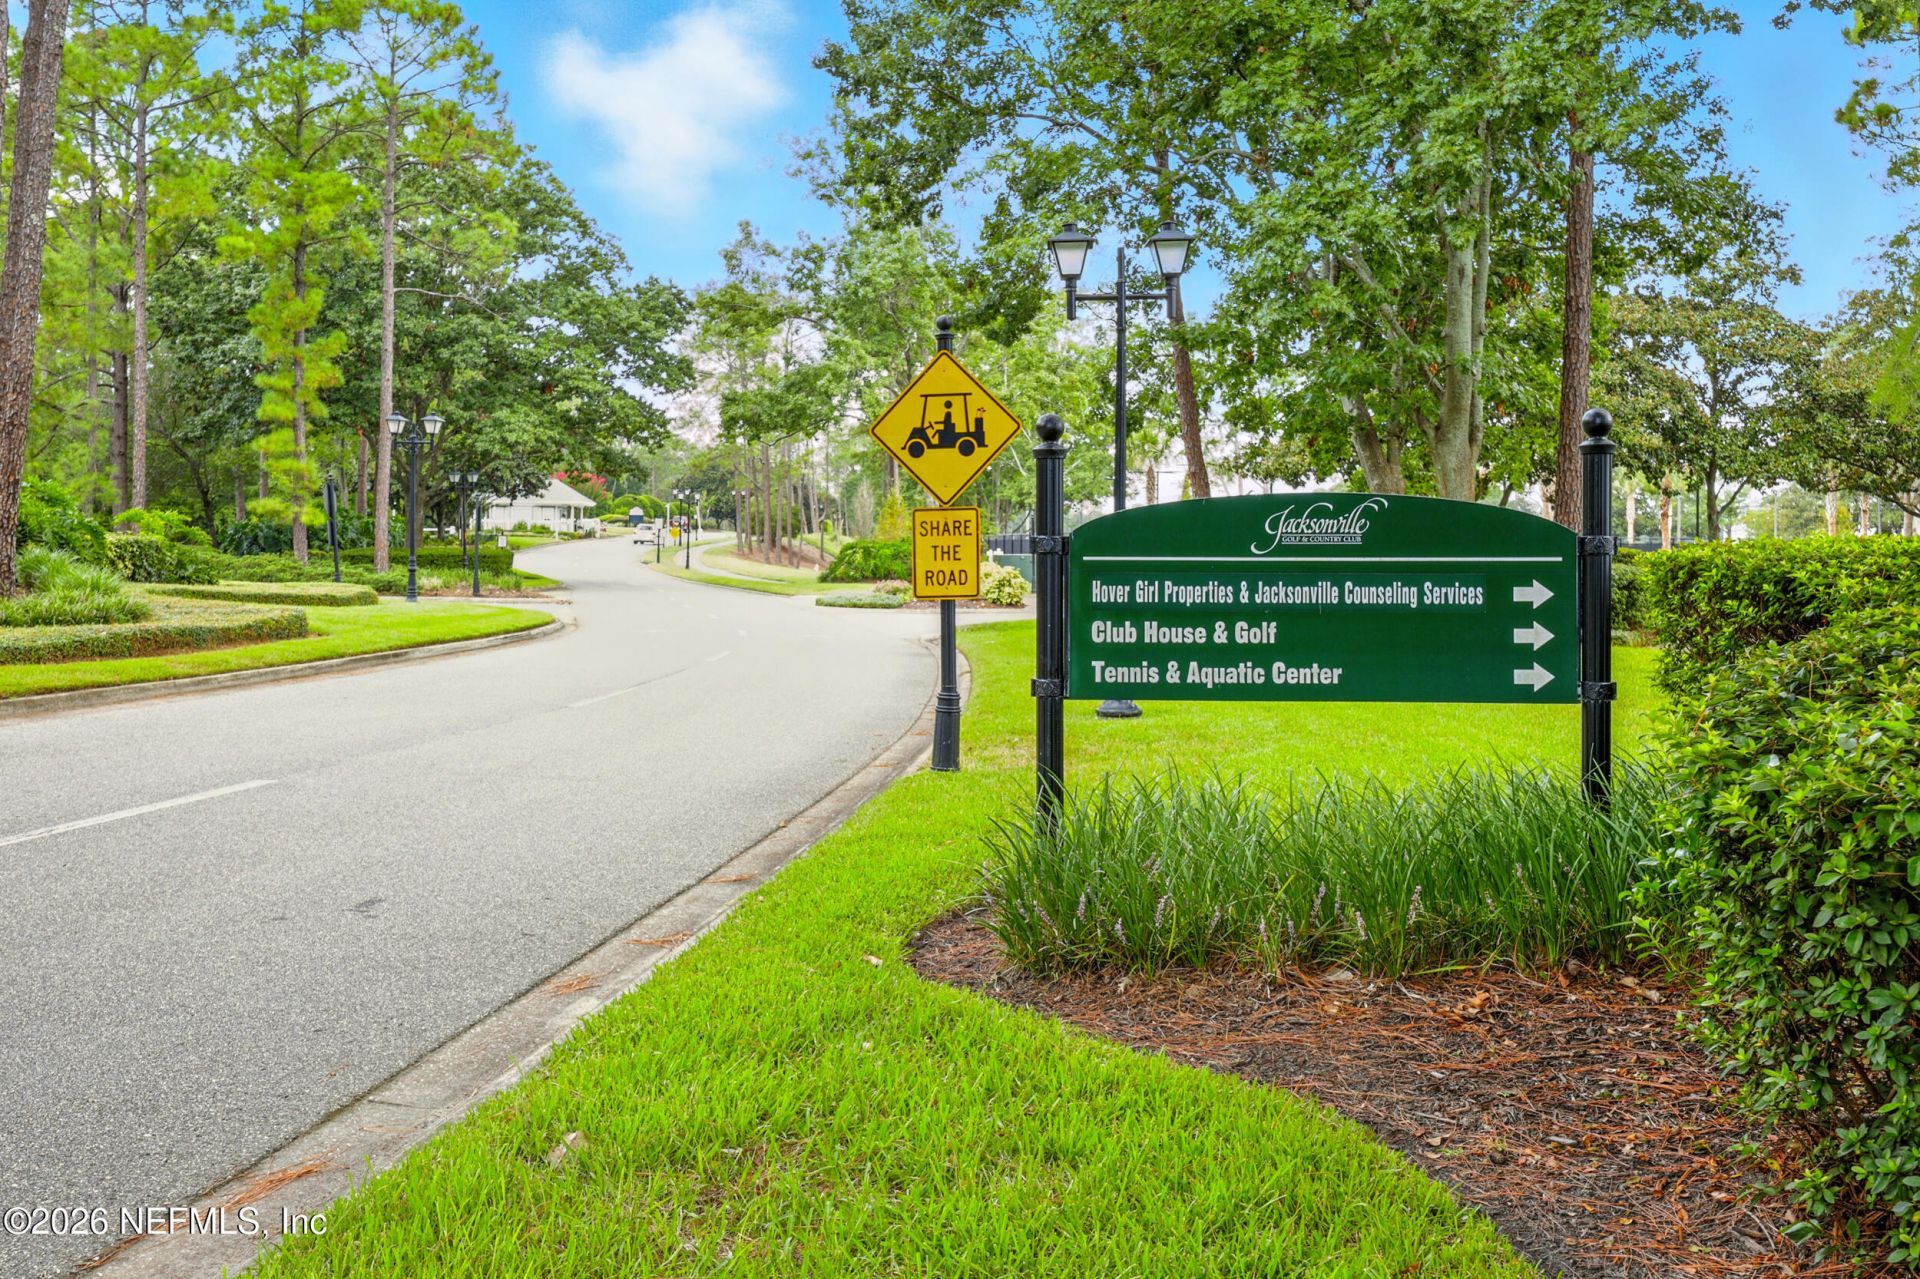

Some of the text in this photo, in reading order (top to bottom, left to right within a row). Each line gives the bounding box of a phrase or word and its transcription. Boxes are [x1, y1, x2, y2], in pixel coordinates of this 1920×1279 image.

[919, 519, 973, 537] SHARE
[1250, 497, 1389, 555] Jacksonville
[931, 544, 962, 561] THE
[925, 569, 969, 586] ROAD
[1092, 580, 1484, 609] Hover Girl Properties & Jacksonville Counseling Services
[1091, 620, 1277, 644] Club House & Golf
[1091, 660, 1343, 689] Tennis & Aquatic Center
